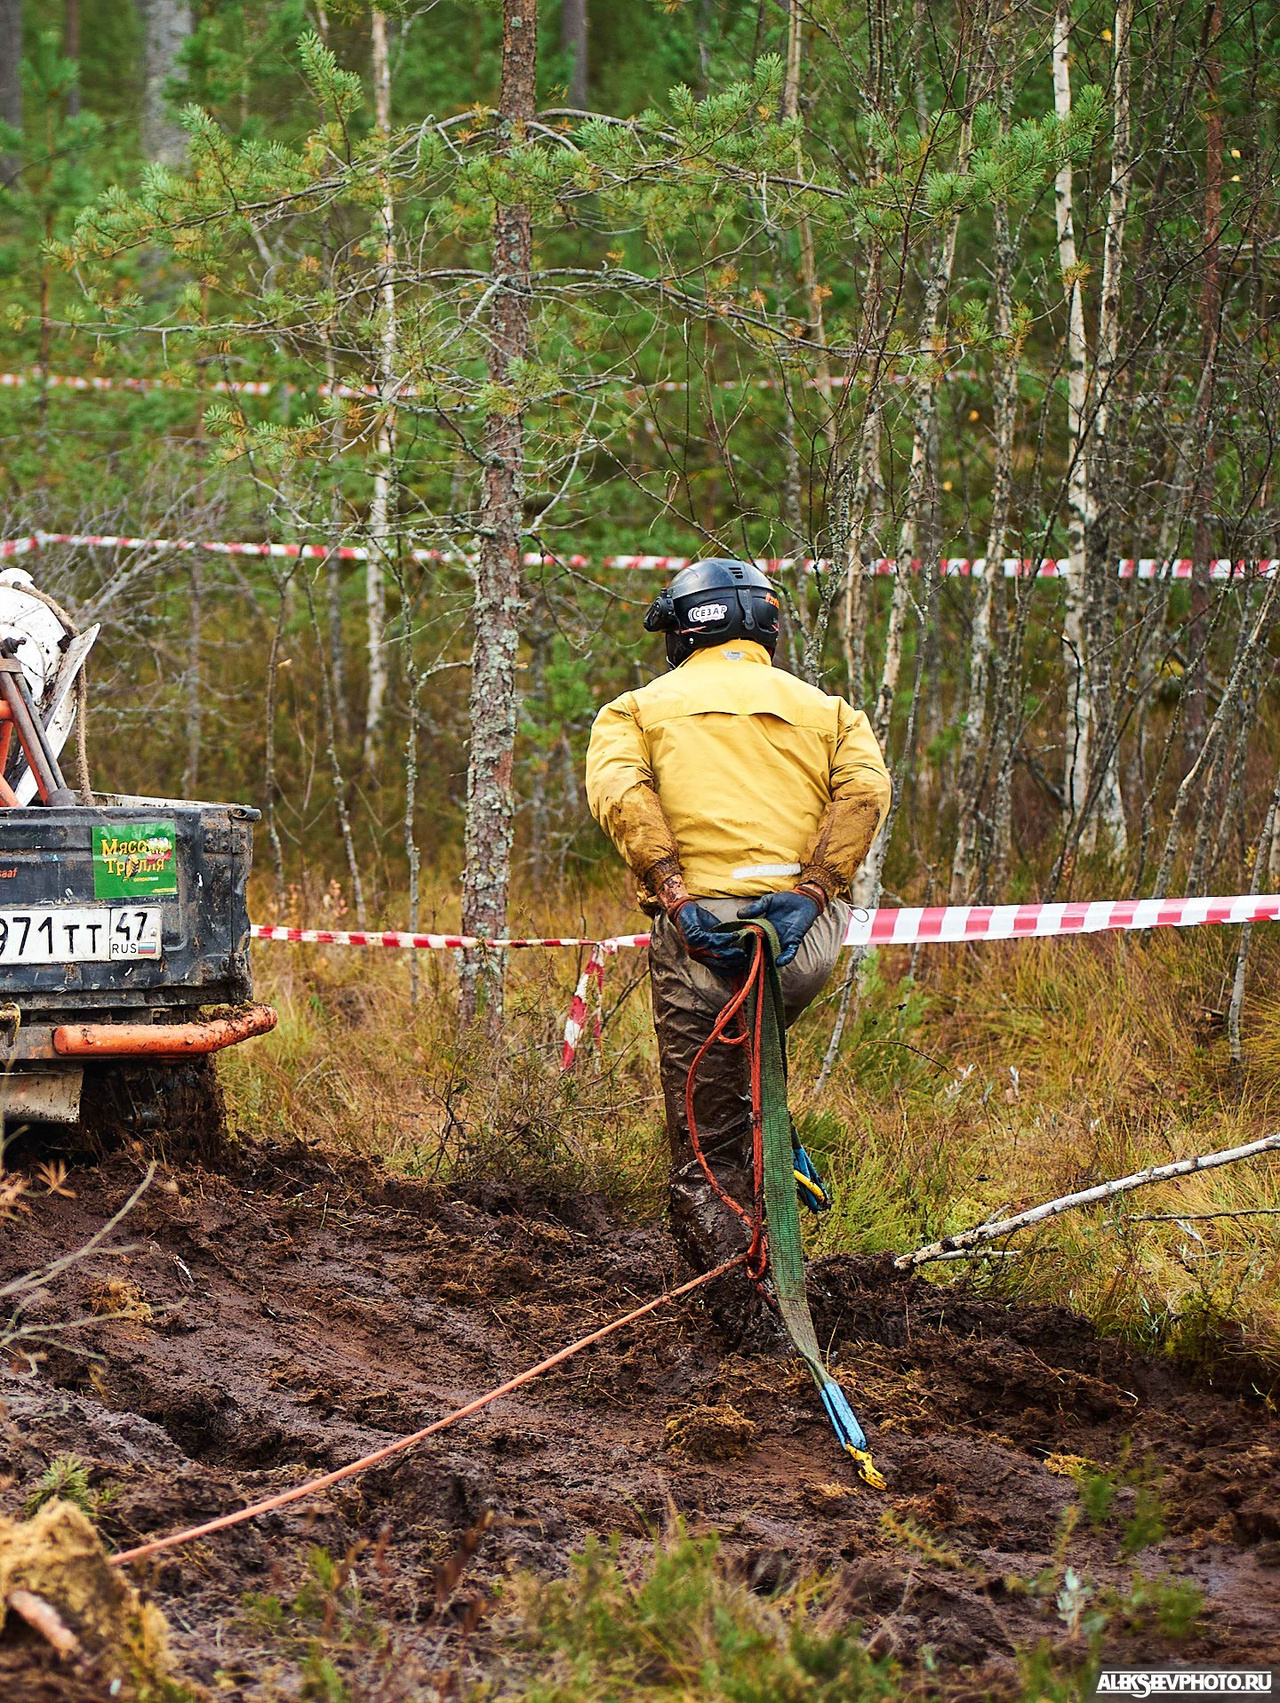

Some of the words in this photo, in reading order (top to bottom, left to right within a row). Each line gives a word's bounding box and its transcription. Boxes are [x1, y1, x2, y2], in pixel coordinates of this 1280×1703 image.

[101, 838, 148, 856] Мясо
[103, 857, 165, 876] Трлля
[116, 912, 148, 941] 47
[111, 943, 137, 954] RUS
